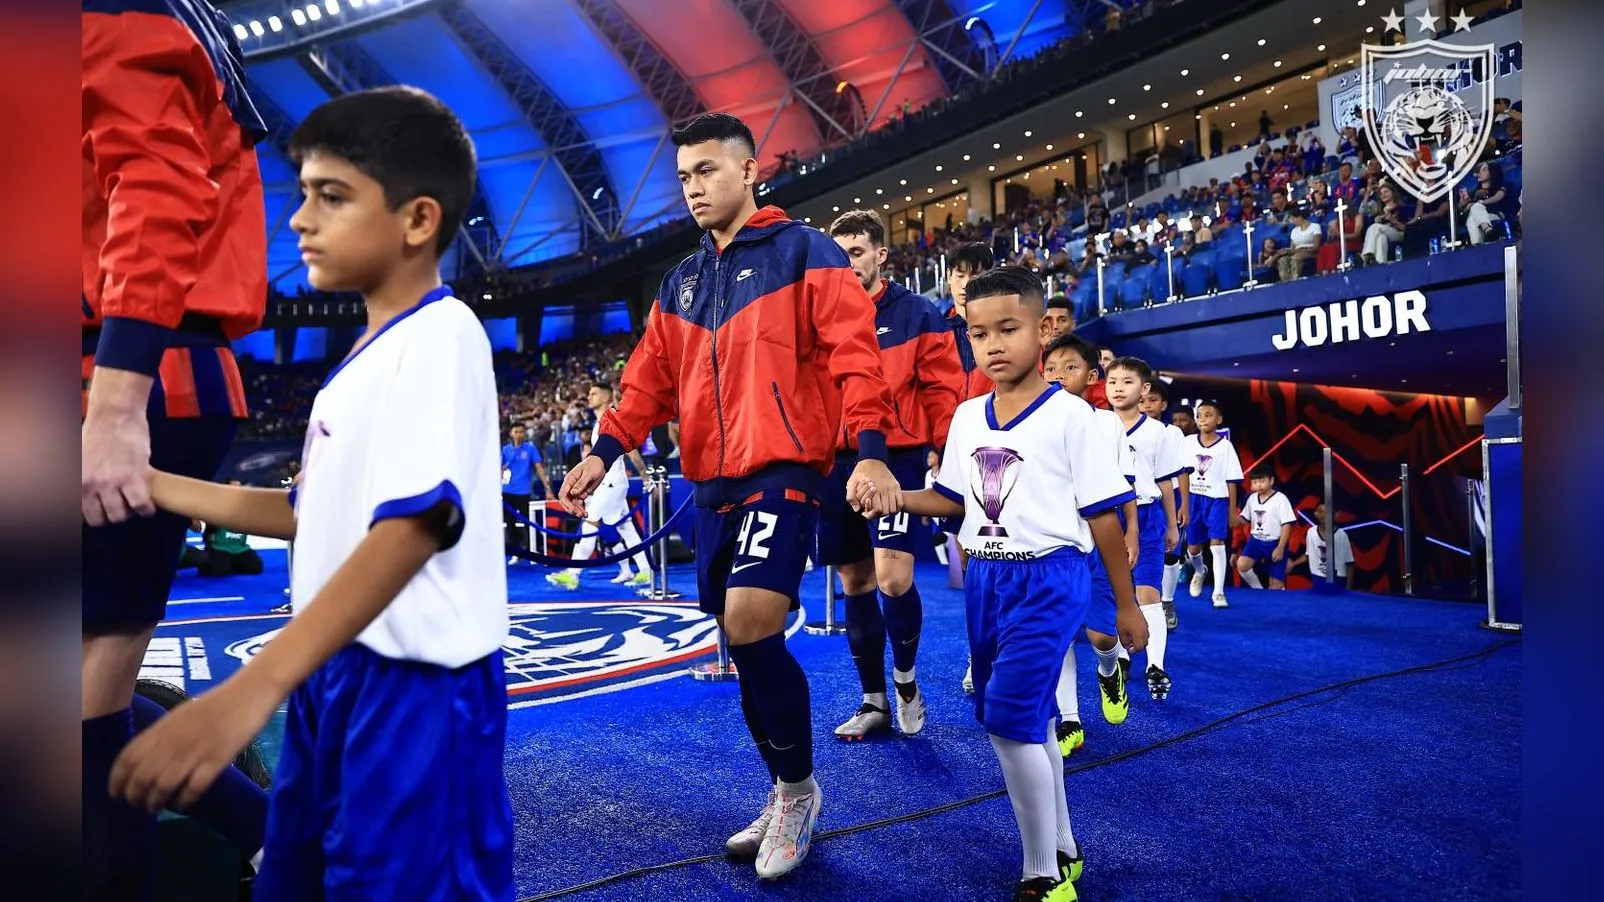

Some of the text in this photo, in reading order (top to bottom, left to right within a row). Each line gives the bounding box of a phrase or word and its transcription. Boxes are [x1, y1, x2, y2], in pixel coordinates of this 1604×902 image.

[1272, 290, 1430, 350] JOHOR
[737, 511, 778, 558] 42
[984, 541, 1004, 550] AFC
[964, 548, 1035, 561] CHAMPIONS
